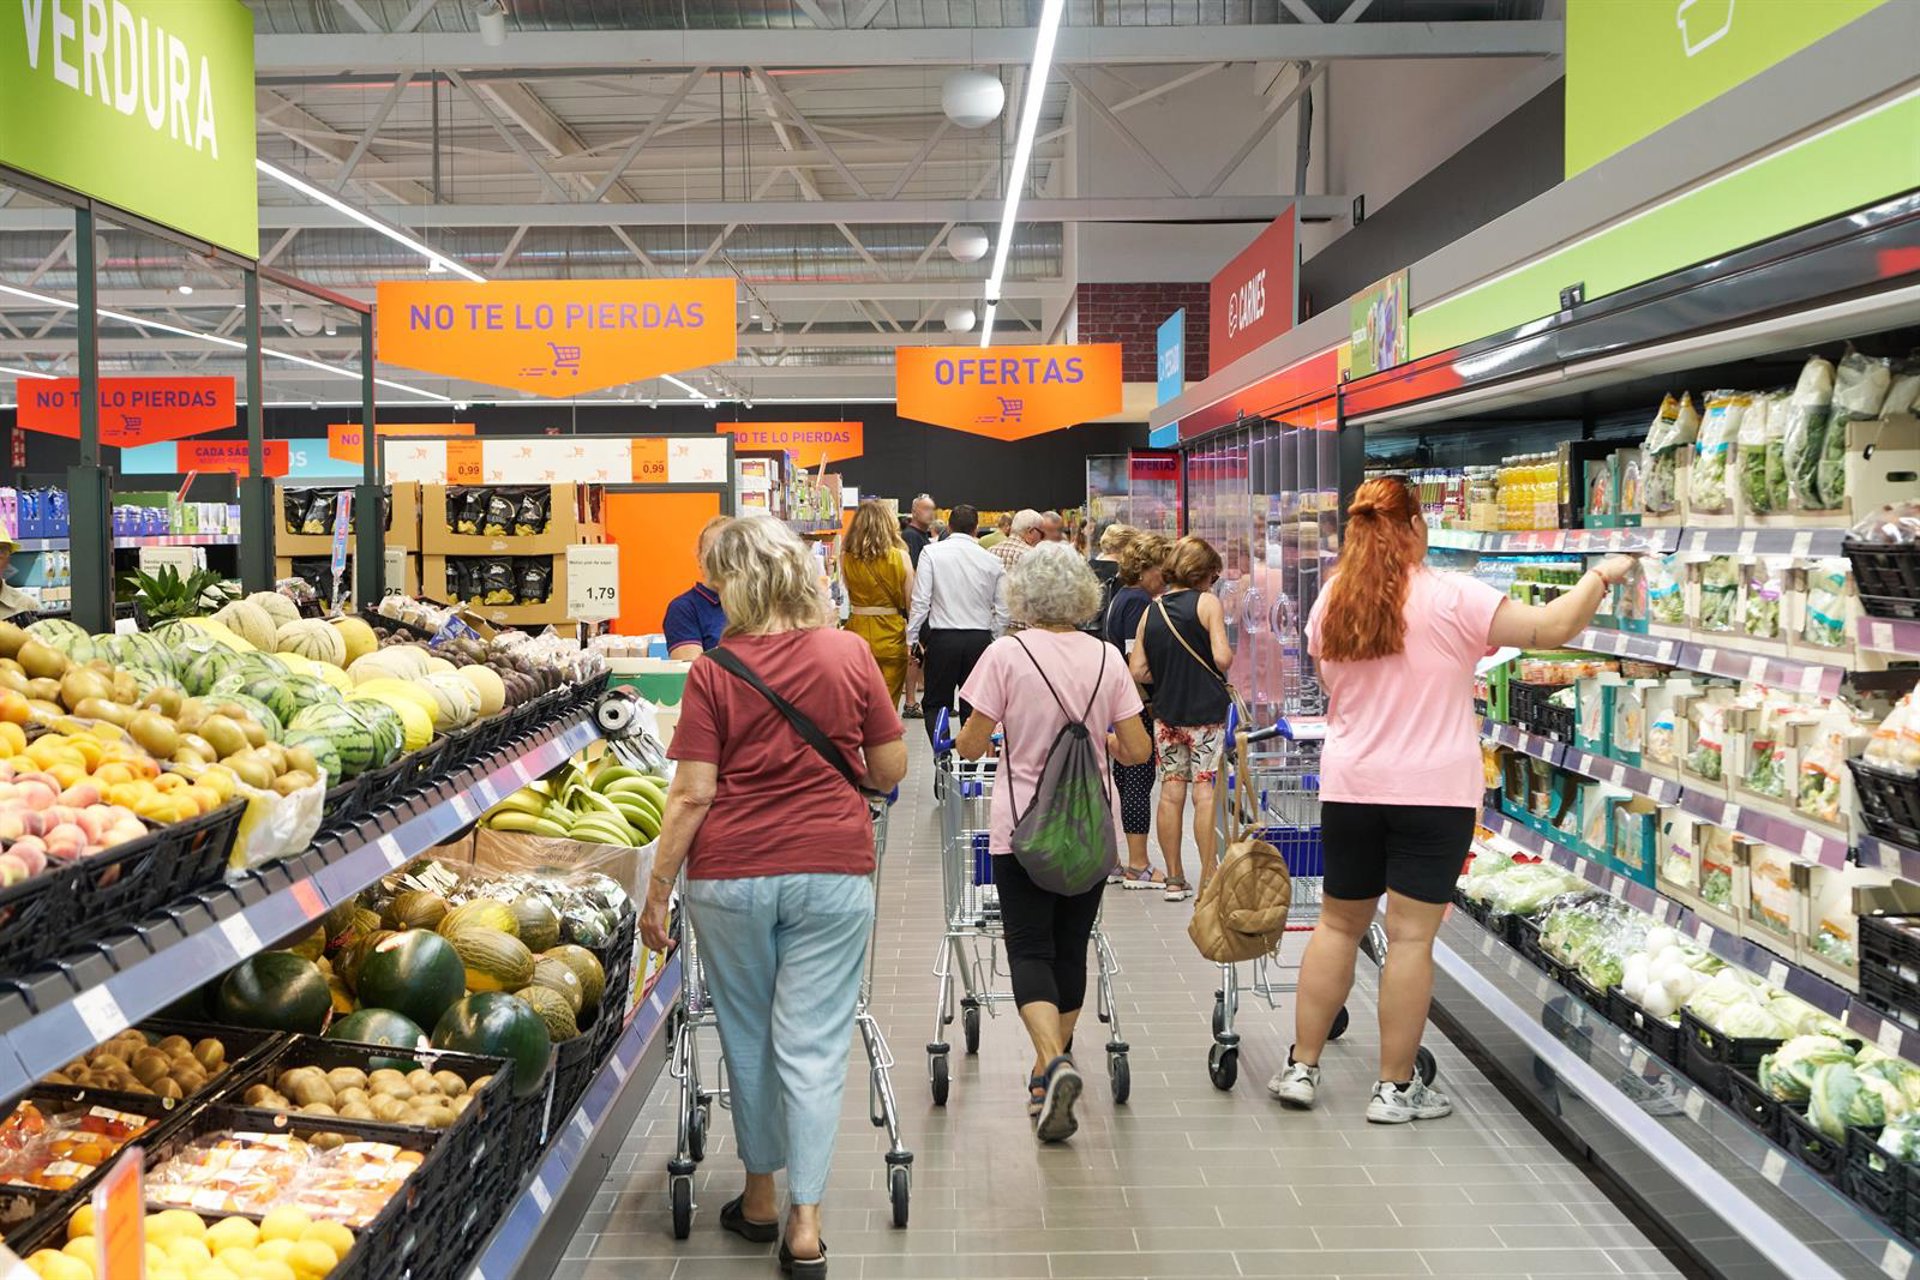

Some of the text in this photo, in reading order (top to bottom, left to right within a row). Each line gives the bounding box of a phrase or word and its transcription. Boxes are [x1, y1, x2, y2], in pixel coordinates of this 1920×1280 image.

[22, 0, 219, 160] VERDURA
[1239, 268, 1266, 331] CARNES
[410, 302, 705, 330] NO TE LO PIERDAS
[935, 357, 1084, 386] OFERTAS
[37, 390, 217, 407] NO T LO PIERDAS
[340, 434, 360, 445] NO
[752, 431, 767, 443] TE
[772, 431, 788, 443] LO
[792, 431, 850, 443] PIERDAS
[195, 447, 225, 457] CADA
[586, 587, 616, 601] 1,79
